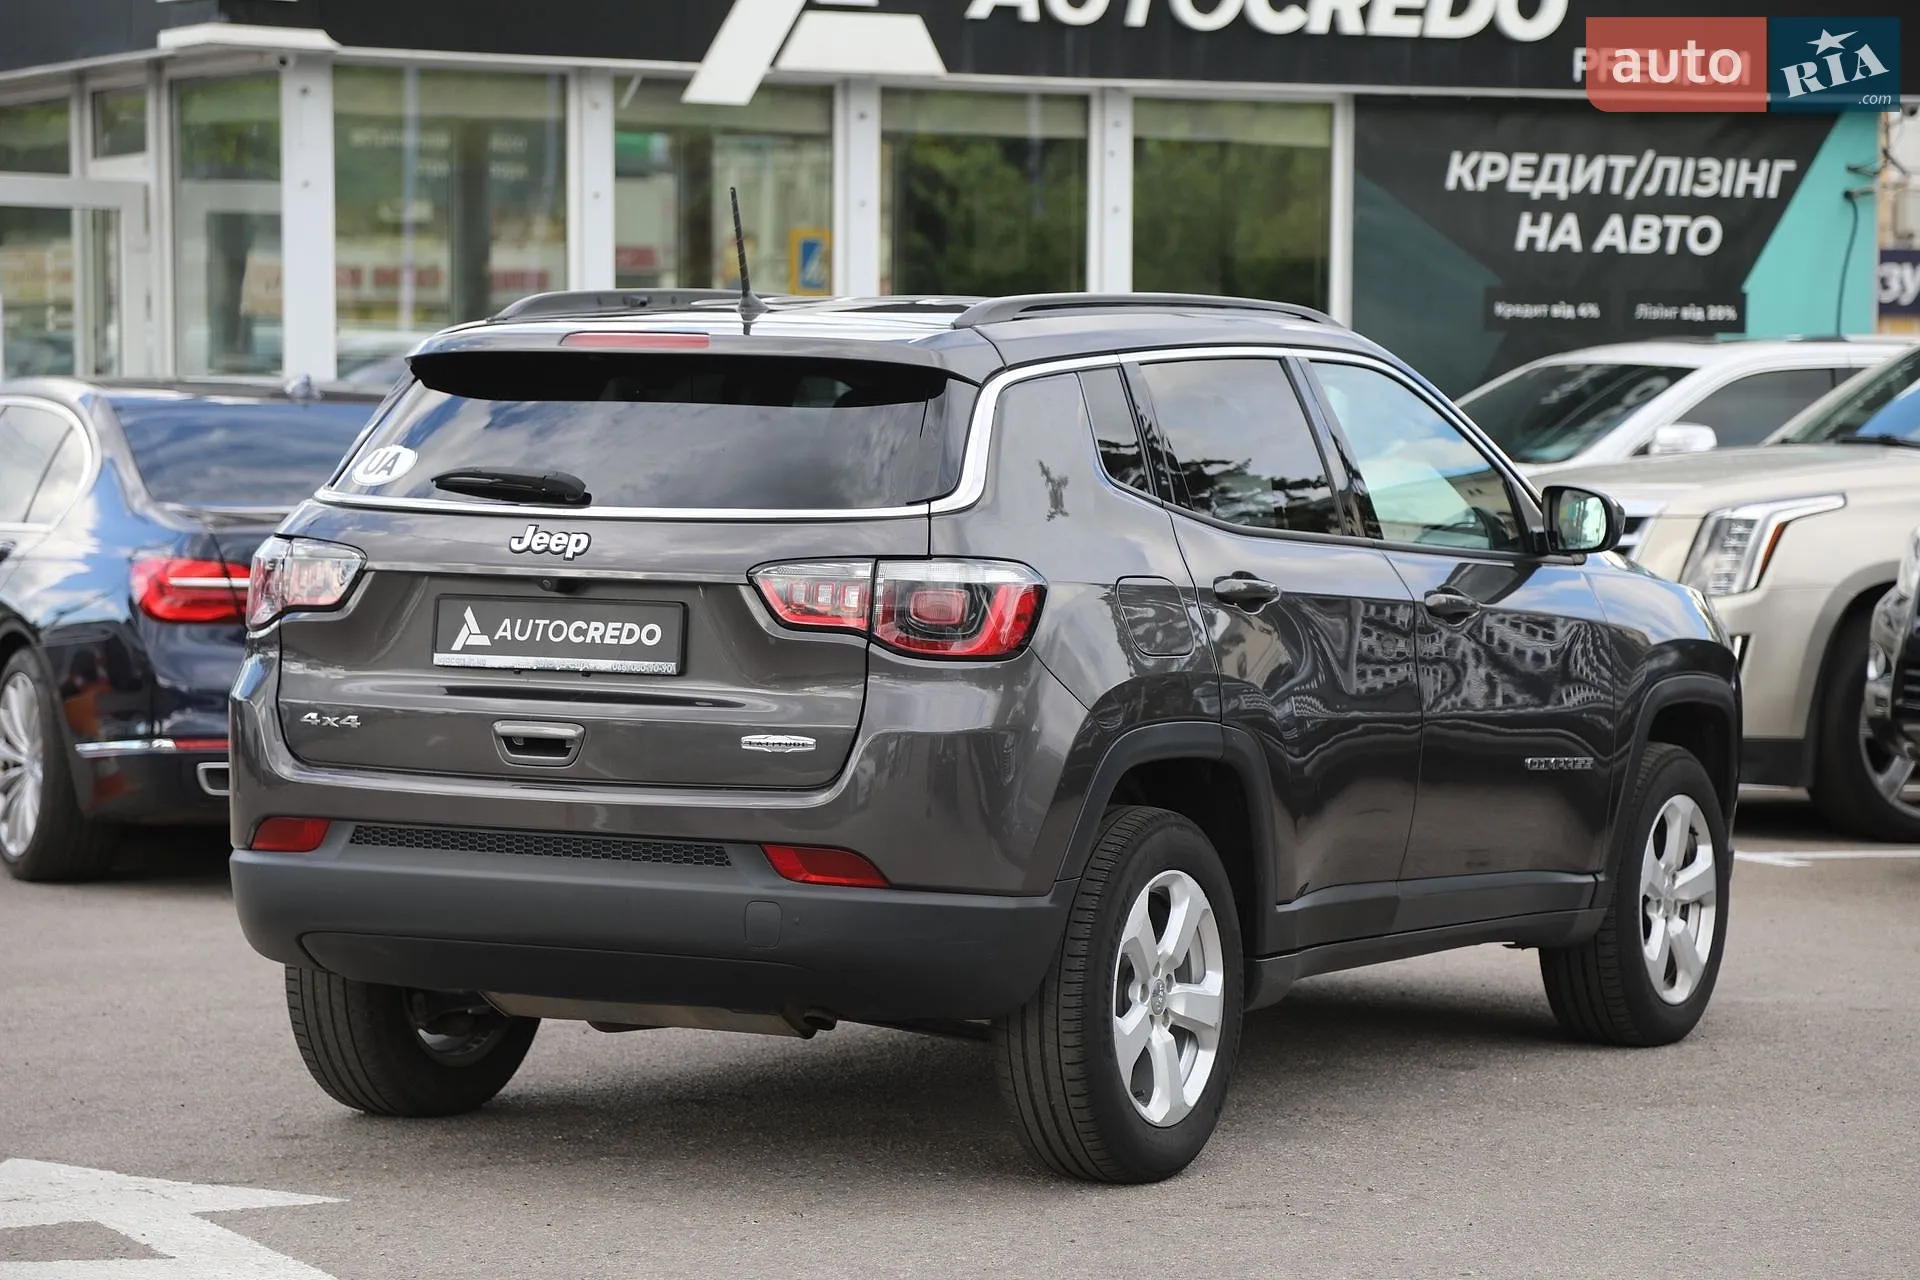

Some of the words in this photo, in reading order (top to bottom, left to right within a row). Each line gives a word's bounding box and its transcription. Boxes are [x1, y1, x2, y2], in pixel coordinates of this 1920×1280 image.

[1445, 150, 1796, 199] КРЕДИТ/ЛІЗІНГ
[1514, 212, 1582, 252] НА
[1592, 214, 1723, 256] АВТО
[361, 450, 402, 477] UA
[509, 523, 592, 560] Jeep
[494, 618, 662, 647] AUTOCREDO
[300, 711, 361, 729] 4x4
